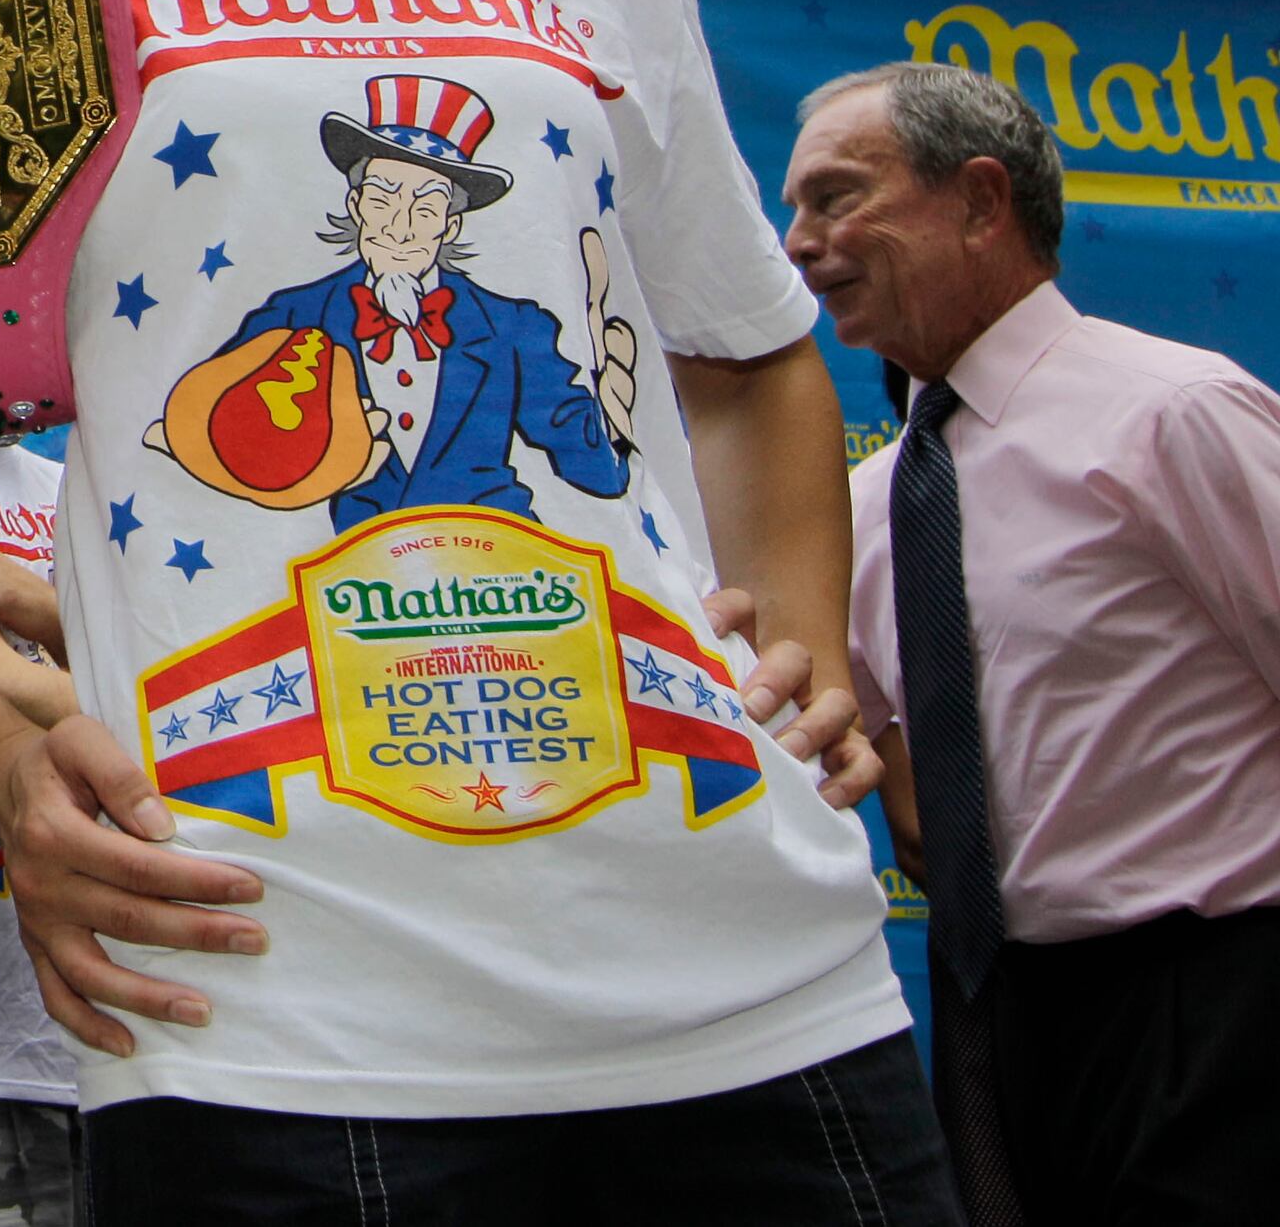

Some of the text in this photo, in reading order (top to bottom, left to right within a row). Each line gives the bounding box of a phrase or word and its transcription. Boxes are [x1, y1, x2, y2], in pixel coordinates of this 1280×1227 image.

[299, 39, 424, 55] FAMOUS
[391, 536, 495, 558] SINCE 1916
[325, 570, 575, 623] Nathan's
[396, 652, 539, 677] INTERNATIONAL
[362, 676, 581, 708] HOT DOG
[387, 706, 568, 737] EATING
[369, 737, 595, 767] CONTEST
